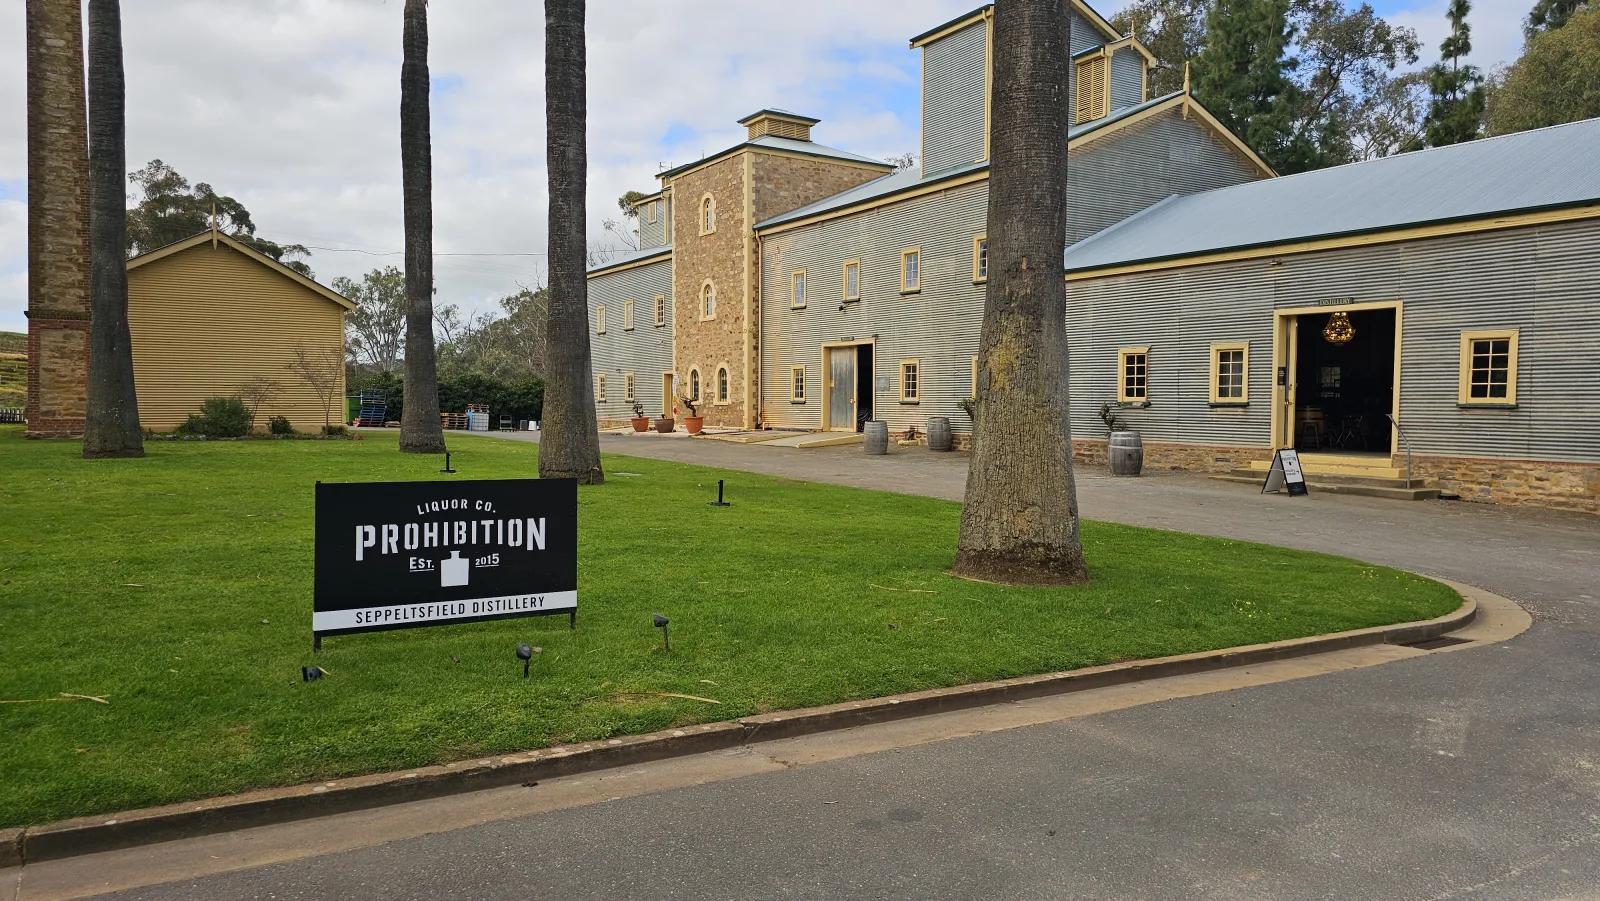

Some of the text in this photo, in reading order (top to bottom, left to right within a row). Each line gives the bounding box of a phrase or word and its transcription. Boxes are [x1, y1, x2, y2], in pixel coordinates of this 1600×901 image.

[416, 498, 496, 515] LIQUOR CO.
[355, 517, 546, 562] PROHIBITION
[475, 553, 500, 566] 2015
[355, 596, 546, 624] SEPPELTSFIELD DISTILLERY
